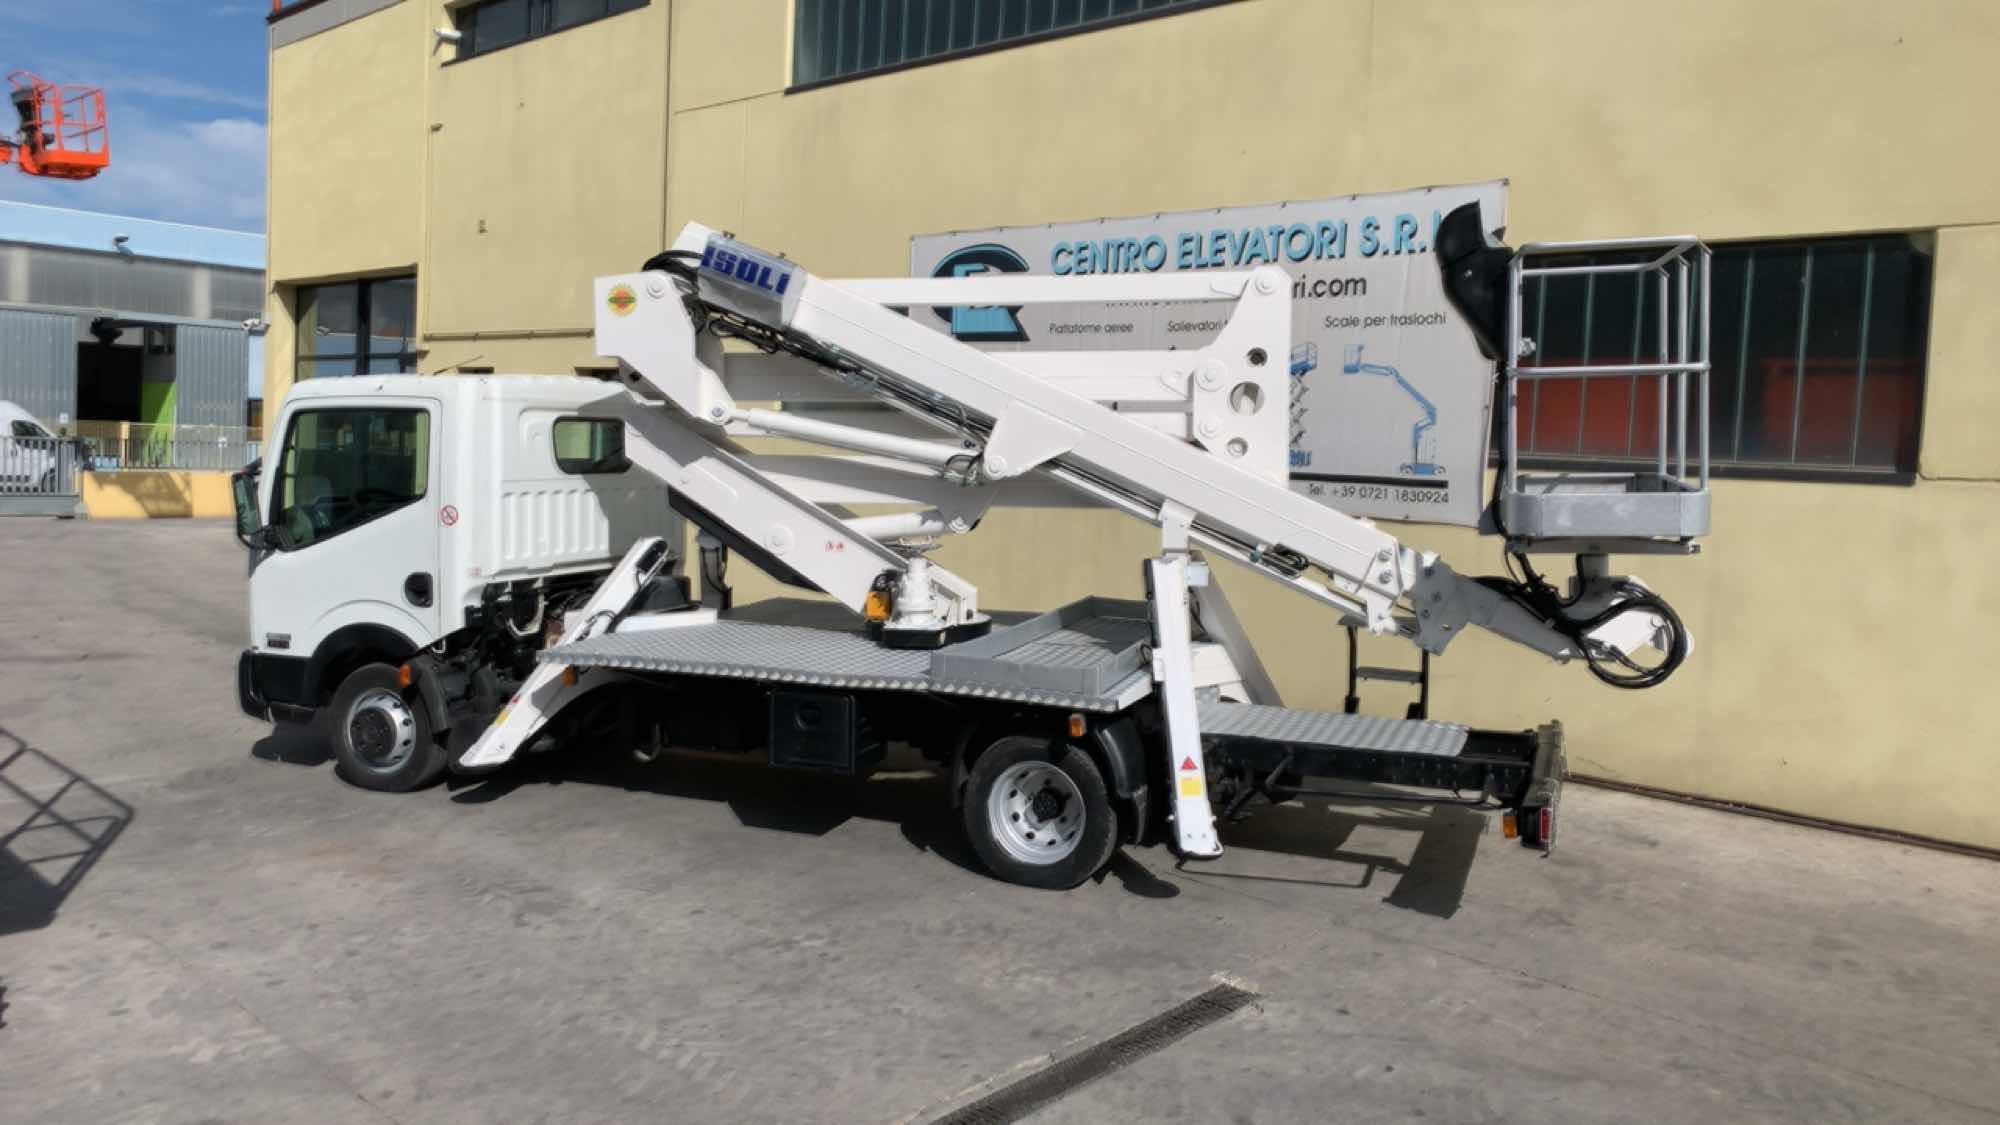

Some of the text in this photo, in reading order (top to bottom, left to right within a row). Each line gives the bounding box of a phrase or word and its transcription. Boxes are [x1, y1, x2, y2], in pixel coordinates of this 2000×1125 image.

[1051, 234, 1168, 276] CENTRO
[1176, 217, 1348, 271] ELEVATORI
[700, 245, 792, 296] ISOLI
[1324, 314, 1360, 329] Scale
[1363, 316, 1385, 329] per
[1359, 486, 1388, 500] 0721
